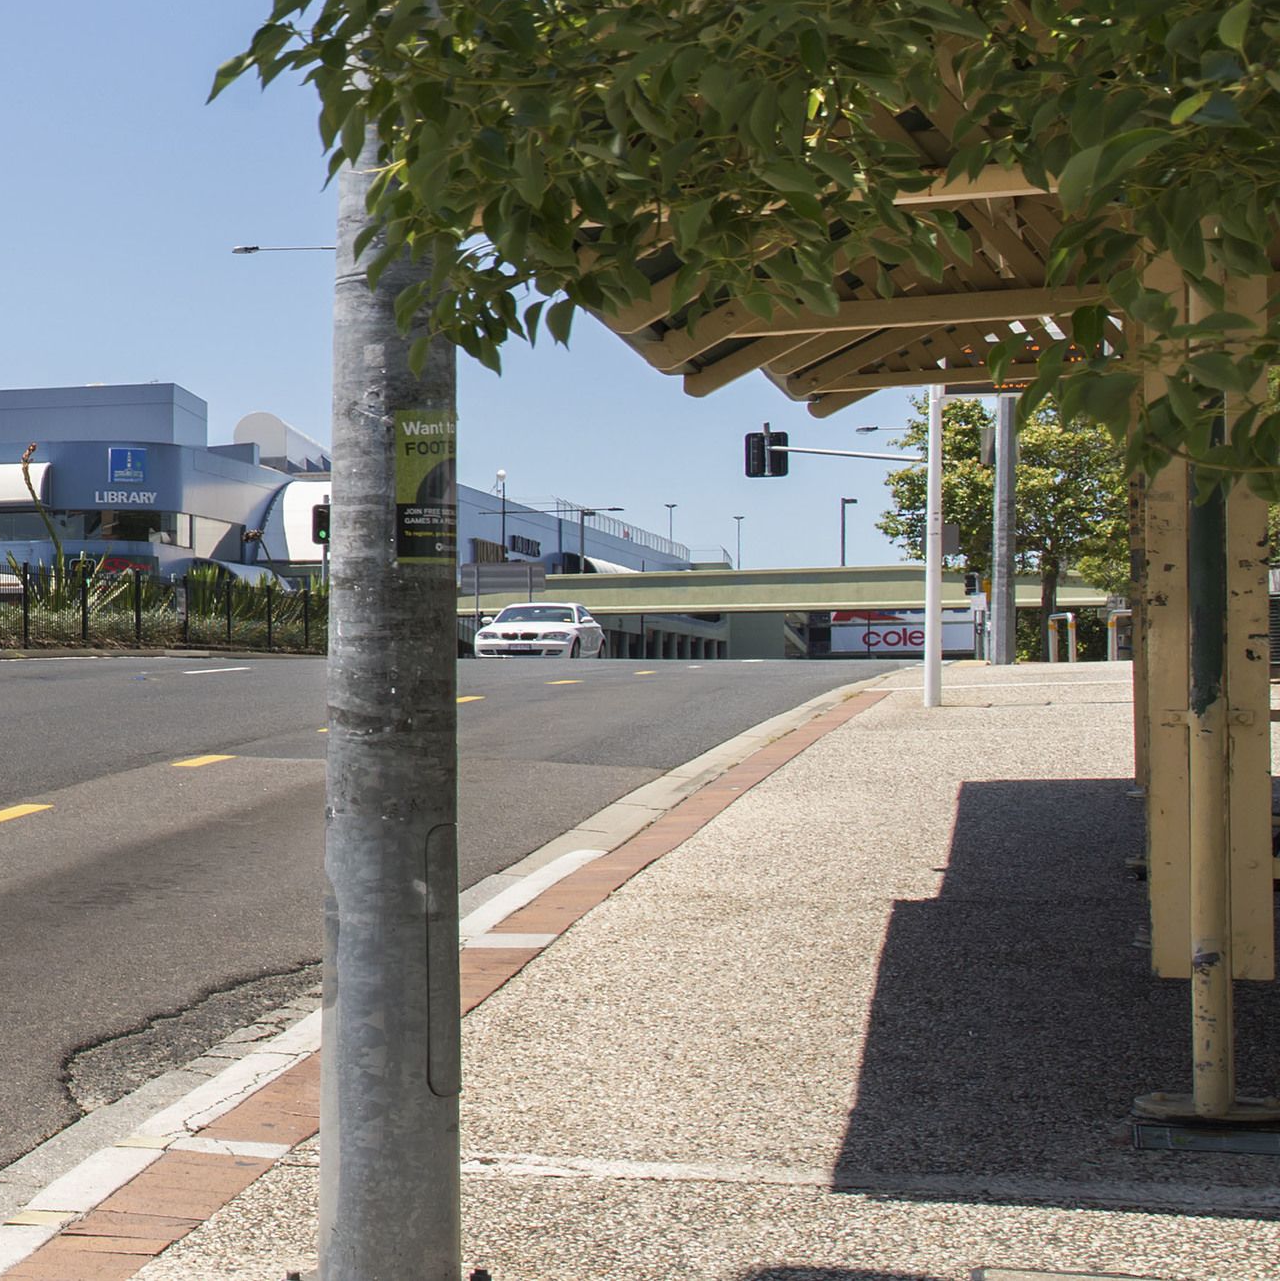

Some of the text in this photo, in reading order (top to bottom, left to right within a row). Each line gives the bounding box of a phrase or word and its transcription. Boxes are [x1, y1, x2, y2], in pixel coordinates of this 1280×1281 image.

[401, 420, 443, 436] Want
[95, 491, 157, 504] LIBRARY
[862, 627, 925, 647] cole
